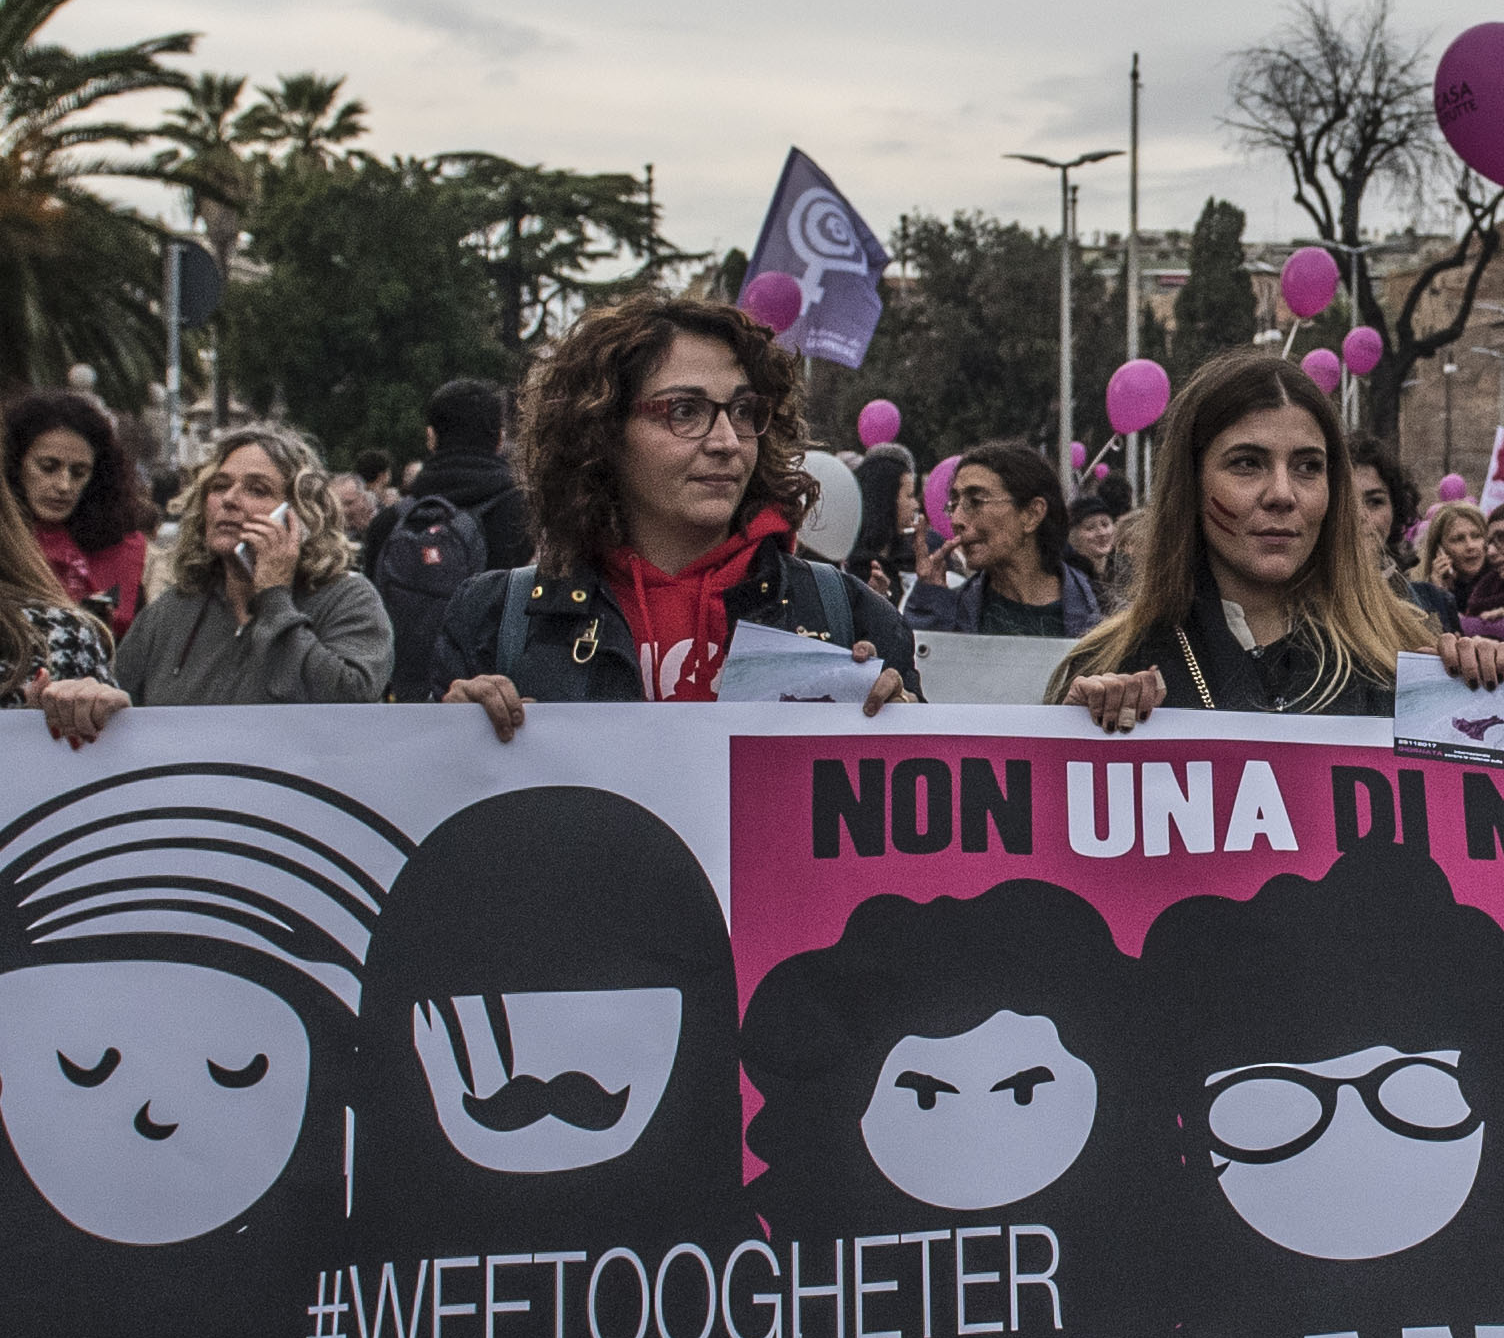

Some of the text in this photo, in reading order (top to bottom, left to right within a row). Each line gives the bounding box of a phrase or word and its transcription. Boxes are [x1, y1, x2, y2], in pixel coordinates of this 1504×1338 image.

[813, 757, 1033, 859] NON
[1066, 760, 1300, 859] UNA
[1333, 765, 1430, 856] DI
